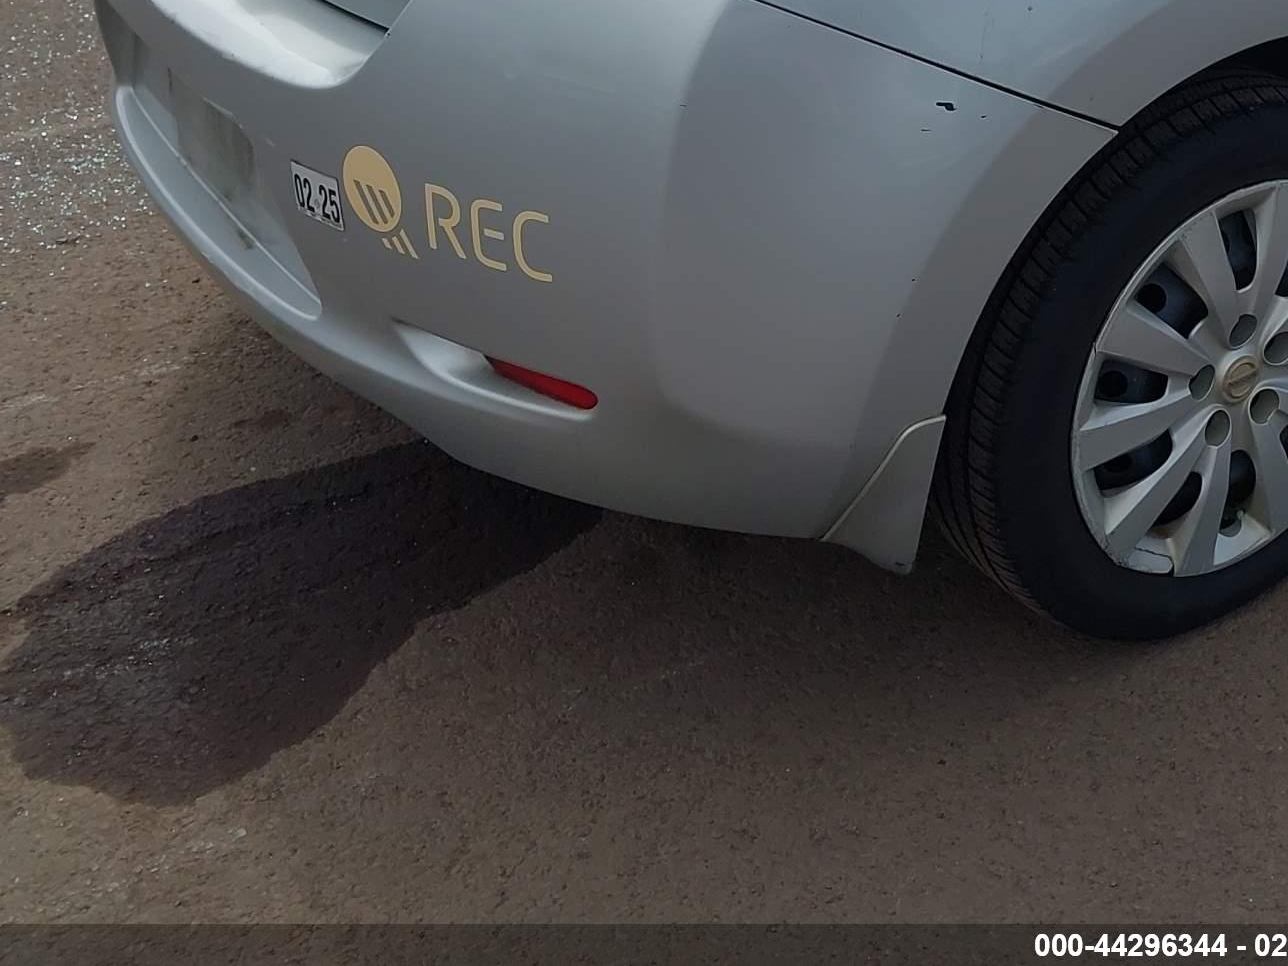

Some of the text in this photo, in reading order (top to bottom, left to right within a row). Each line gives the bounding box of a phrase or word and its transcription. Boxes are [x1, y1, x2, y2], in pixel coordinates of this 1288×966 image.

[294, 173, 340, 223] 02 25
[425, 183, 553, 283] REC
